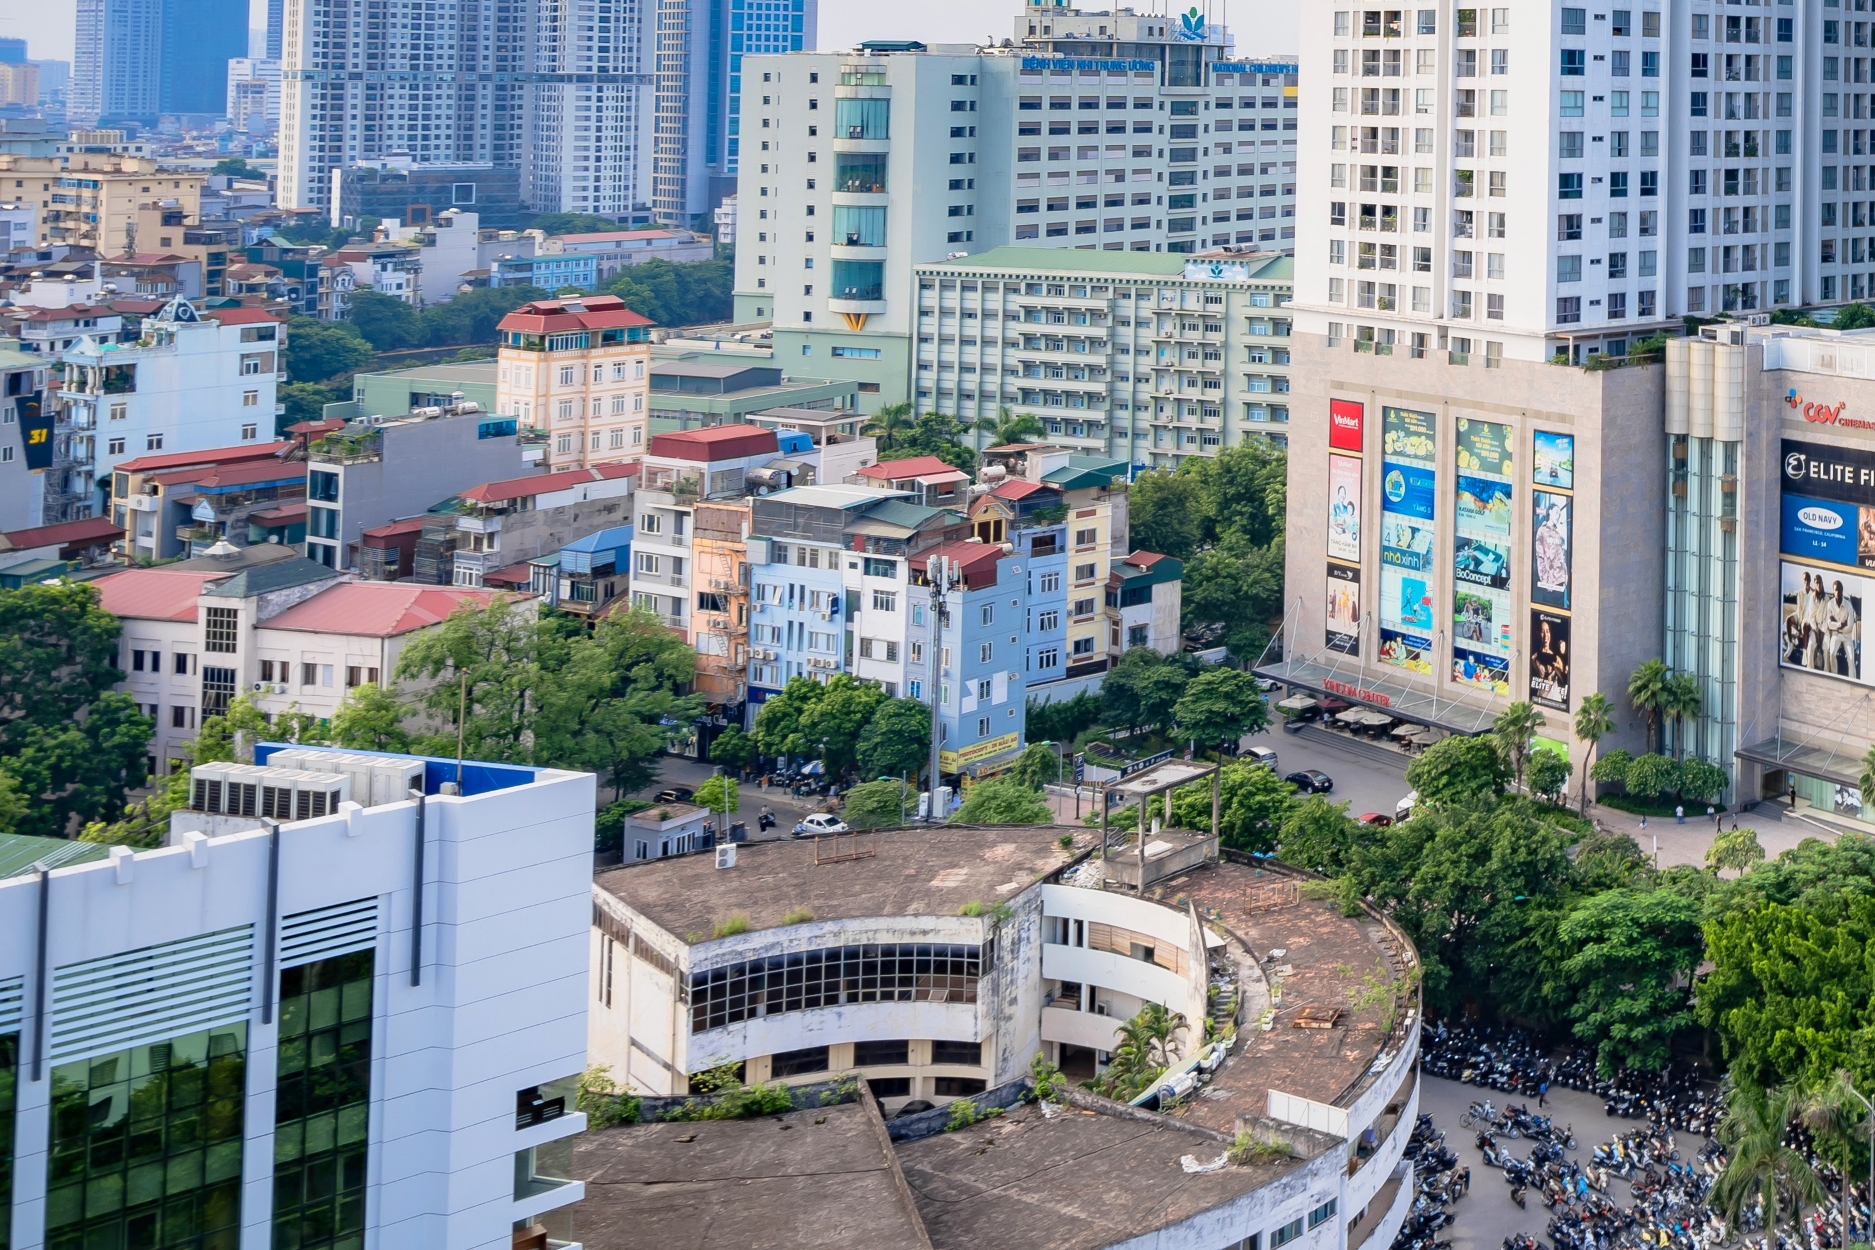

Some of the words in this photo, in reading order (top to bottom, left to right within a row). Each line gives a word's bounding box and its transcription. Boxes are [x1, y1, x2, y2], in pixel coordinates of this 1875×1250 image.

[1022, 55, 1051, 71] BỆNH
[1052, 56, 1075, 72] VIỆN
[1077, 59, 1093, 71] NHI
[1094, 59, 1127, 71] TRUNG
[1212, 63, 1248, 73] NATIONAL
[1333, 413, 1359, 427] VinMart
[1803, 402, 1840, 425] CGV
[28, 428, 48, 445] 31
[1810, 461, 1853, 483] ELITE
[1803, 512, 1817, 521] OLD
[1818, 514, 1837, 524] NAVY
[1384, 532, 1391, 545] 4
[1401, 553, 1419, 568] xinh
[1456, 567, 1491, 586] BoConcept
[1531, 681, 1549, 690] ELITE
[959, 745, 987, 759] PHOTOCOPY
